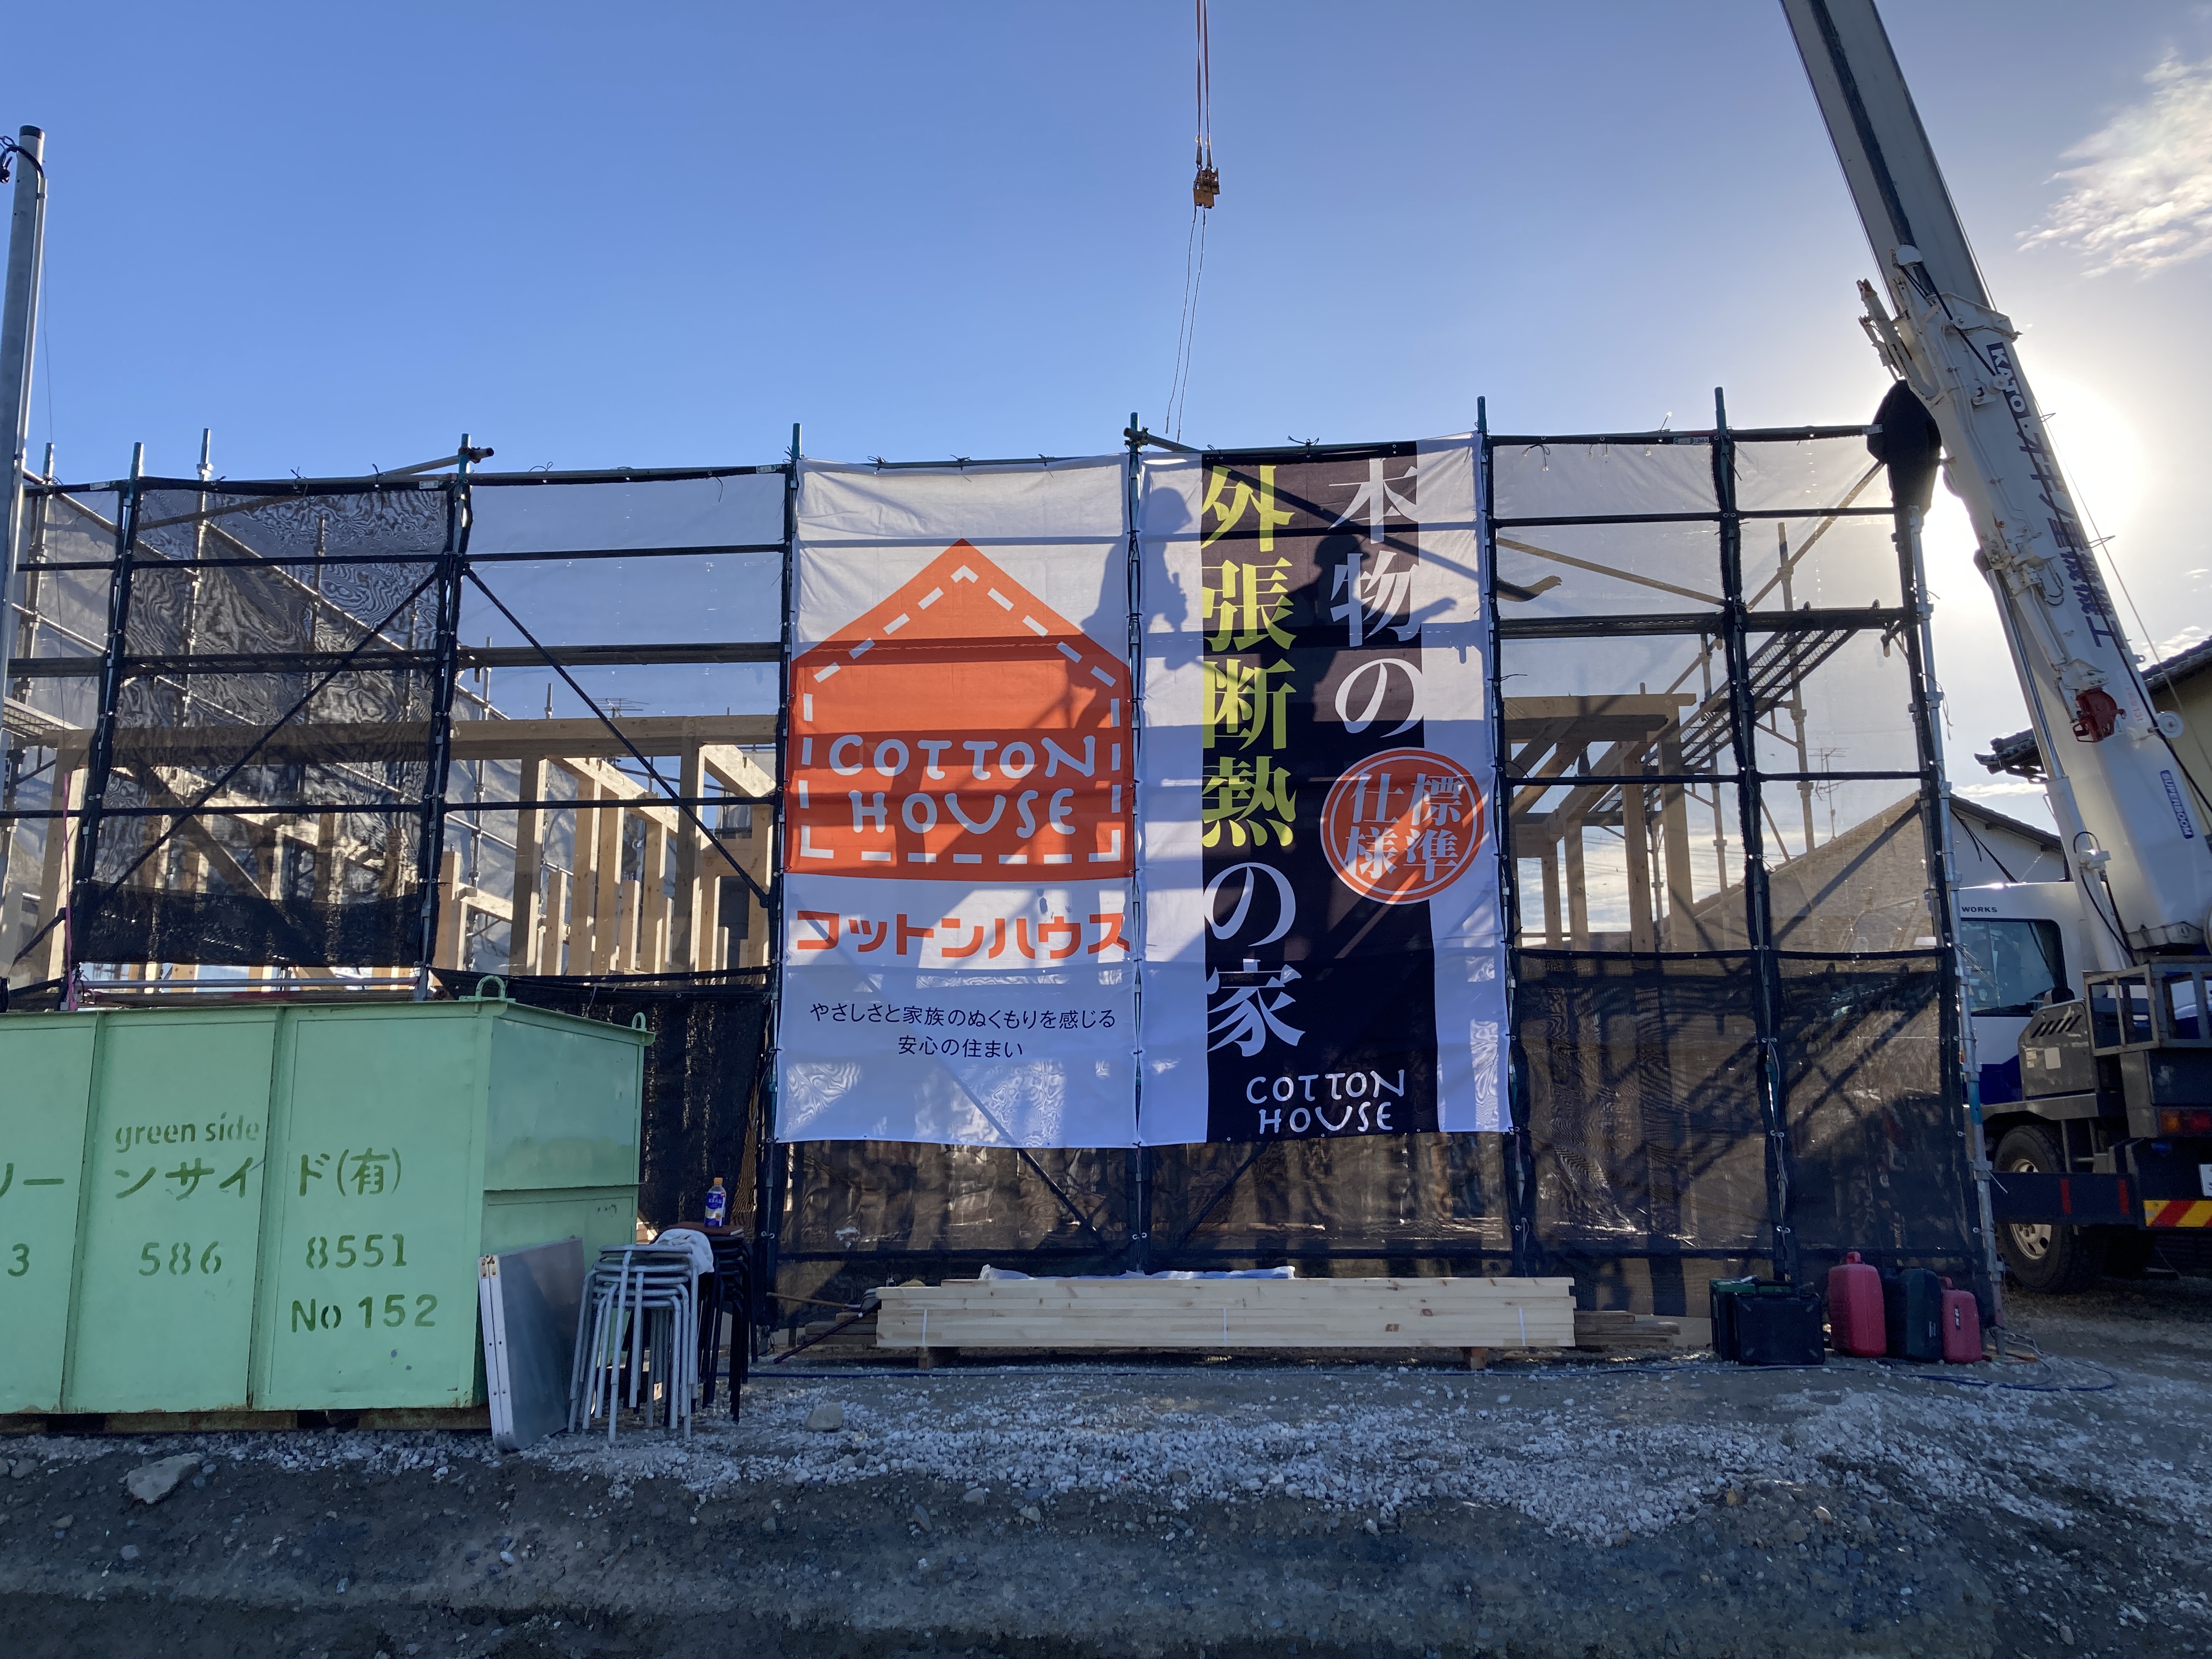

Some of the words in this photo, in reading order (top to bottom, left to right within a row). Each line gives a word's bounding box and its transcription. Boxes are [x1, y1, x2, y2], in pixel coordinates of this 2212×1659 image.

[1991, 347, 2026, 413] KATO
[1328, 457, 1424, 738] 本物の
[829, 734, 1095, 781] COTTON
[1201, 464, 1305, 1057] 外張断熱の家
[849, 788, 1075, 839] HOUSE
[797, 910, 1130, 960] コットンハウス
[810, 1002, 1116, 1030] やさしさと家族のぬくもりを感じる
[898, 1036, 1024, 1059] 安心の住まい
[1246, 1069, 1405, 1104] COTTON
[115, 1123, 196, 1153] green
[205, 1111, 260, 1142] side
[1259, 1101, 1394, 1135] HOUSE
[7, 1243, 30, 1277] 3
[139, 1241, 222, 1276] 586
[306, 1233, 408, 1269] 8551
[292, 1298, 342, 1333] No
[358, 1294, 438, 1328] 152
